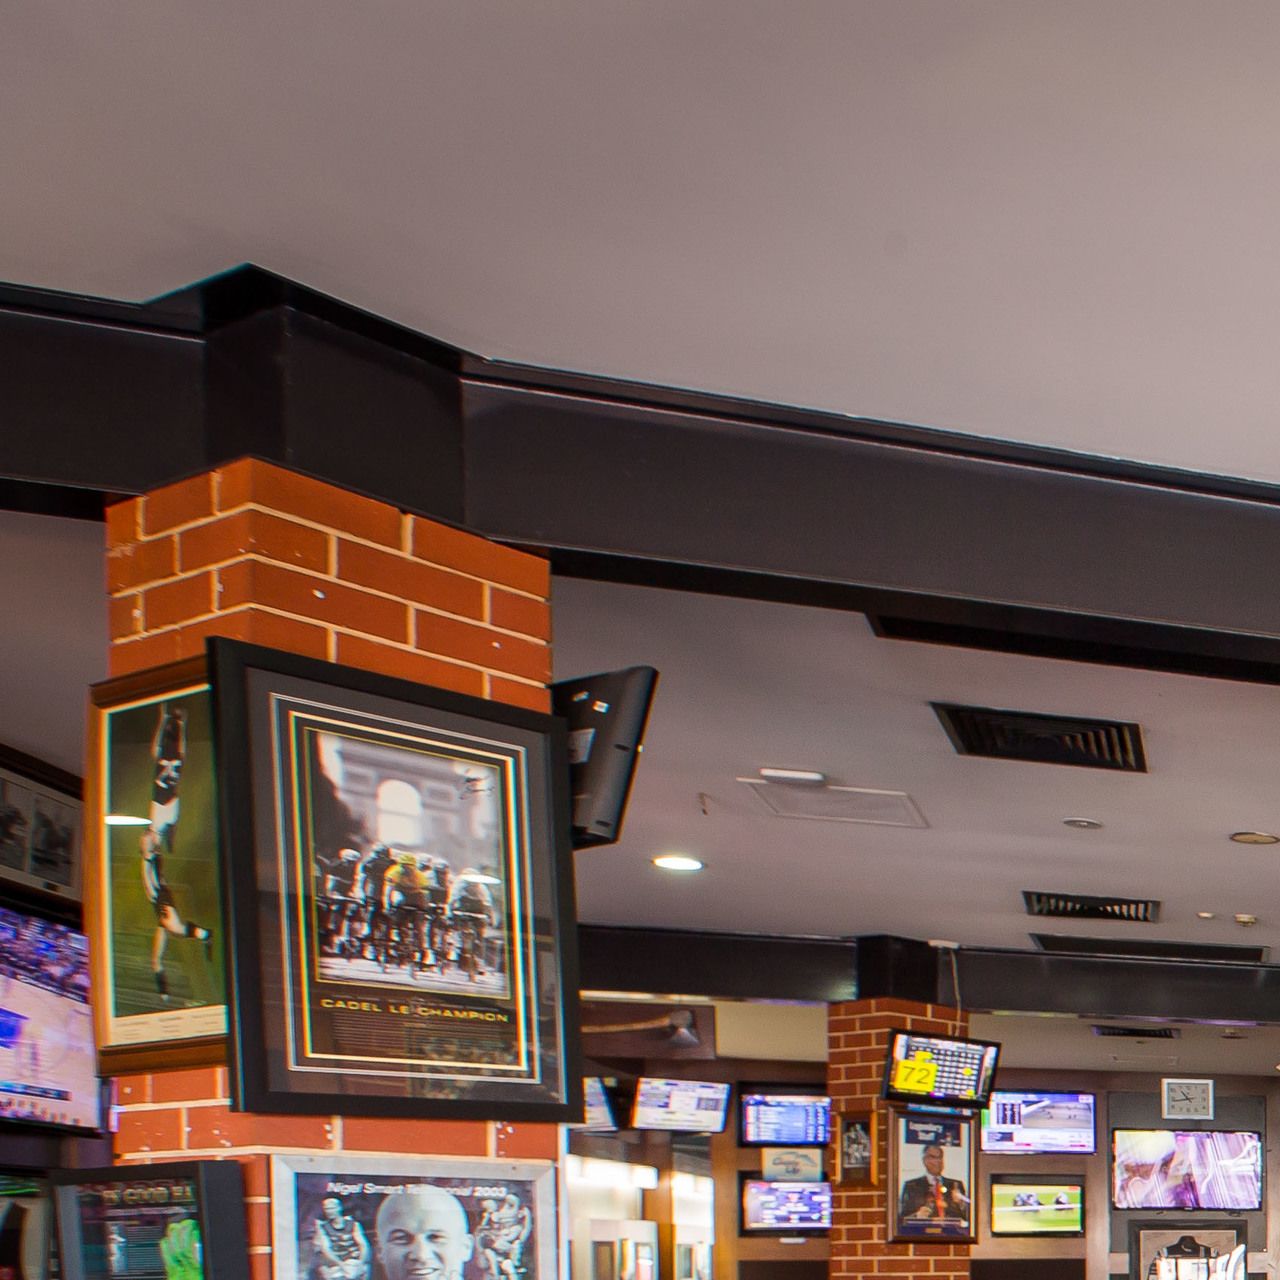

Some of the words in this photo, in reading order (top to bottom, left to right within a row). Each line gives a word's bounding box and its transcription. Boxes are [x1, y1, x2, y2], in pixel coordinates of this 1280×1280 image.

[320, 998, 382, 1012] CADEL
[388, 1004, 410, 1015] LE
[417, 1006, 509, 1023] CHAMPION
[903, 1065, 931, 1085] 72
